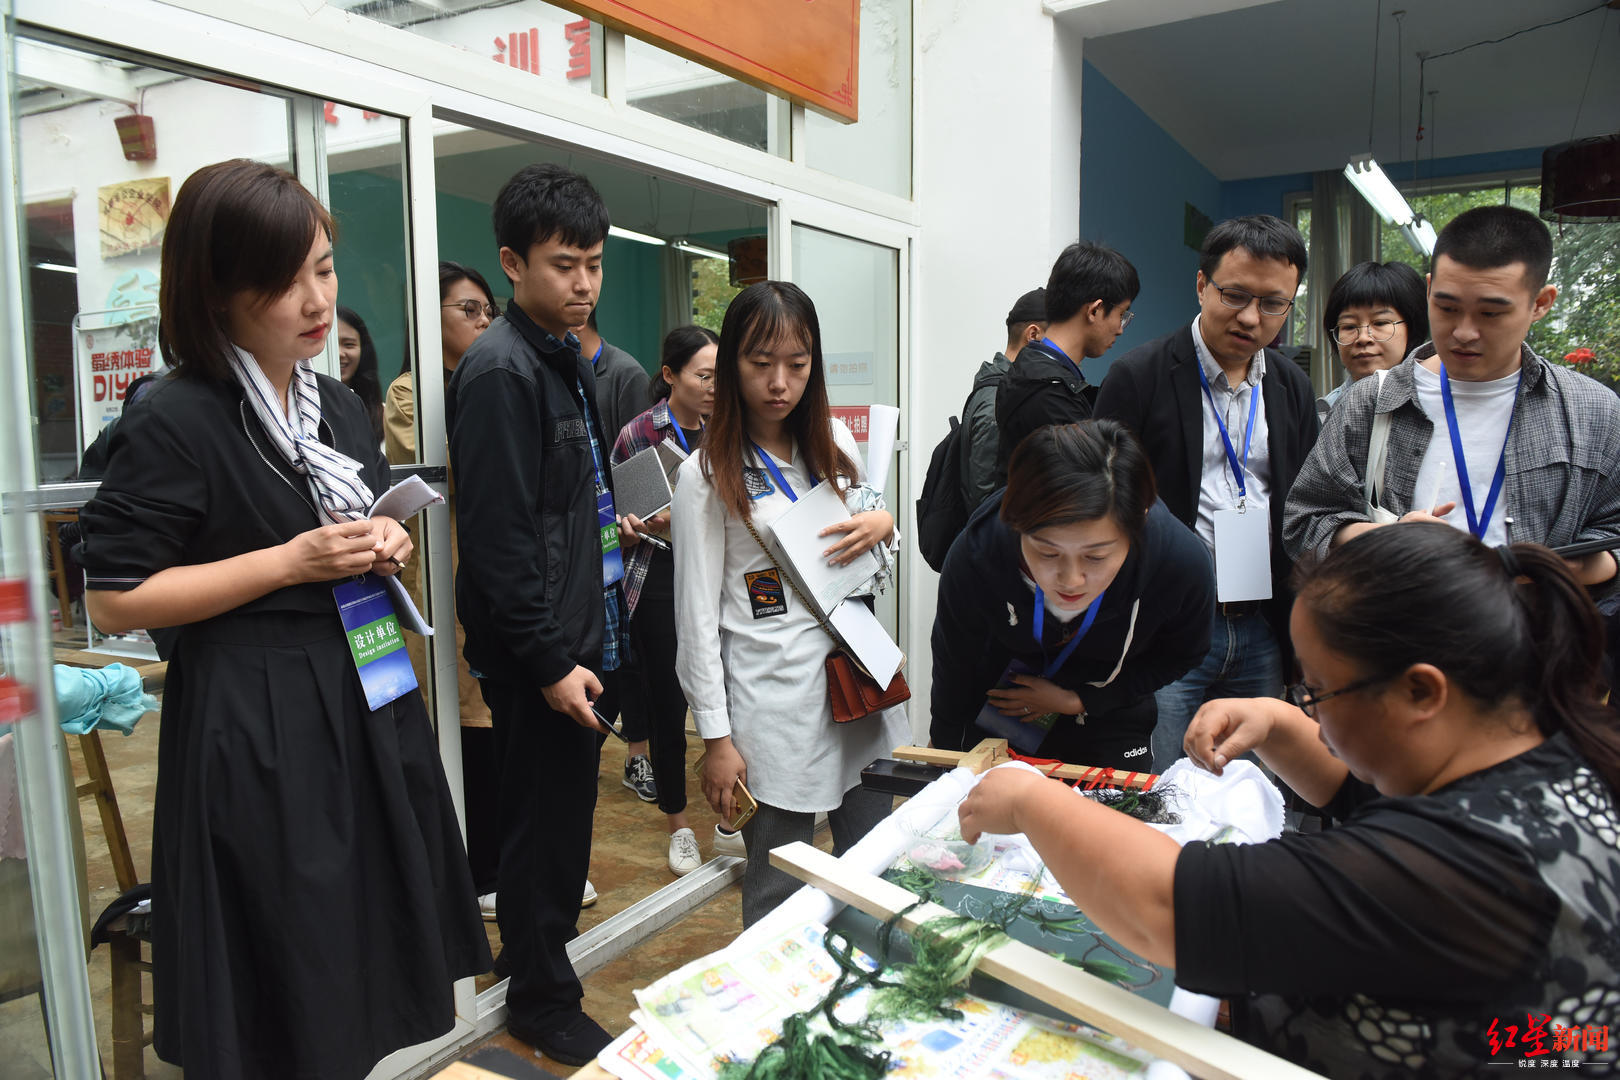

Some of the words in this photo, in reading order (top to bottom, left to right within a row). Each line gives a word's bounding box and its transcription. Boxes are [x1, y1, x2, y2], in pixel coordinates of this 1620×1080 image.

[92, 348, 153, 372] 蜀绣体验
[353, 621, 397, 650] 设计单位
[358, 648, 376, 660] Design
[1123, 746, 1148, 759] adidas
